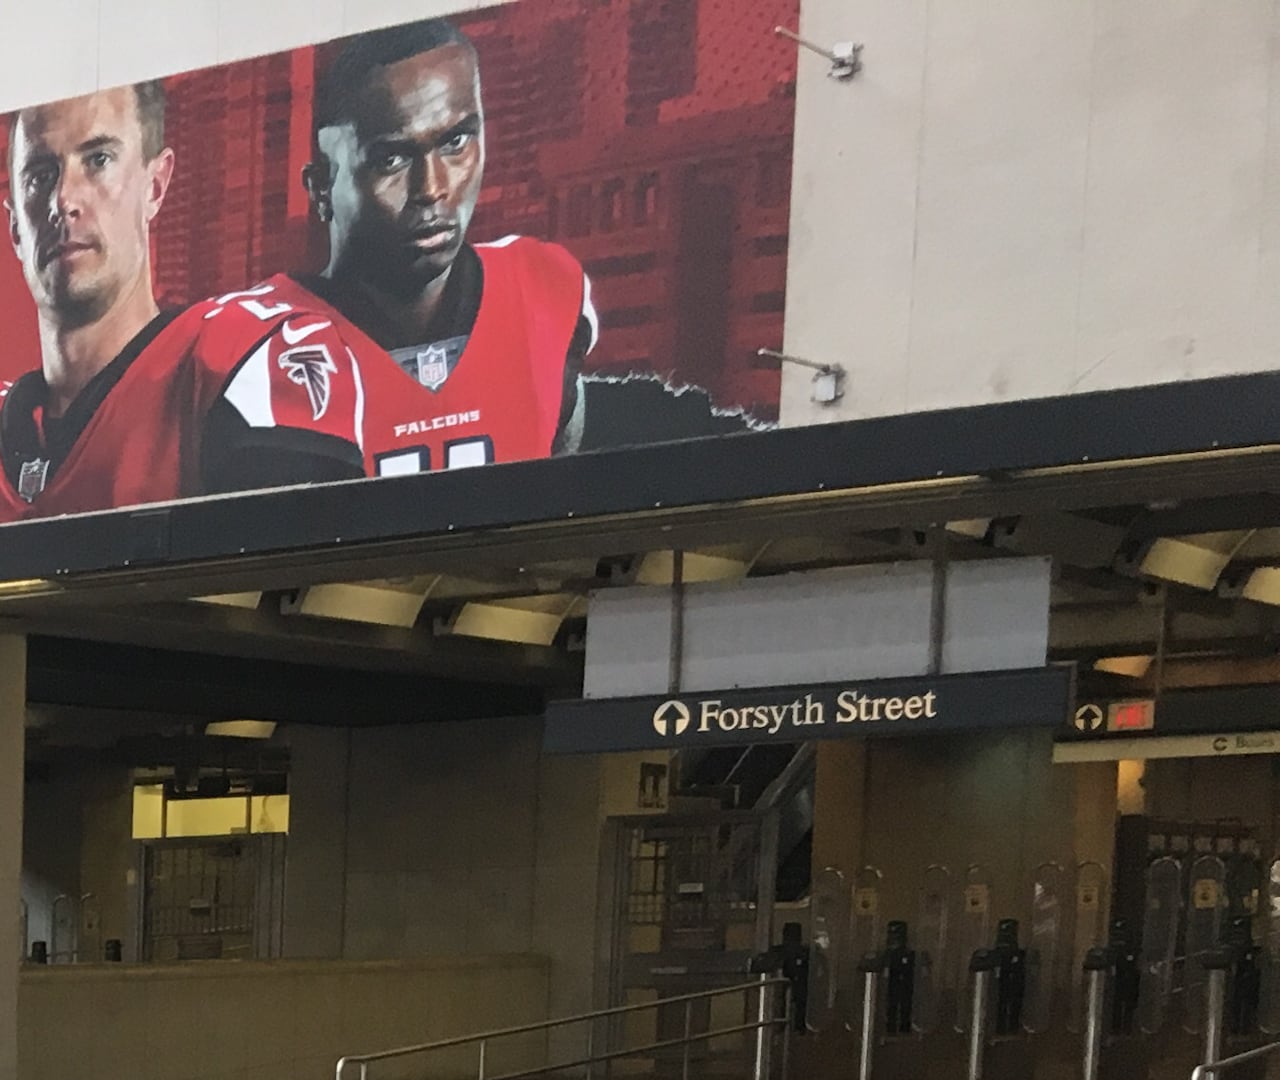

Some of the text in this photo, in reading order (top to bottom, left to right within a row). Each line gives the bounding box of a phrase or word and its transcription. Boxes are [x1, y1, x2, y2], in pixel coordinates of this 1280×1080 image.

[393, 409, 481, 438] FALCONS
[697, 689, 938, 734] Forsyth Street
